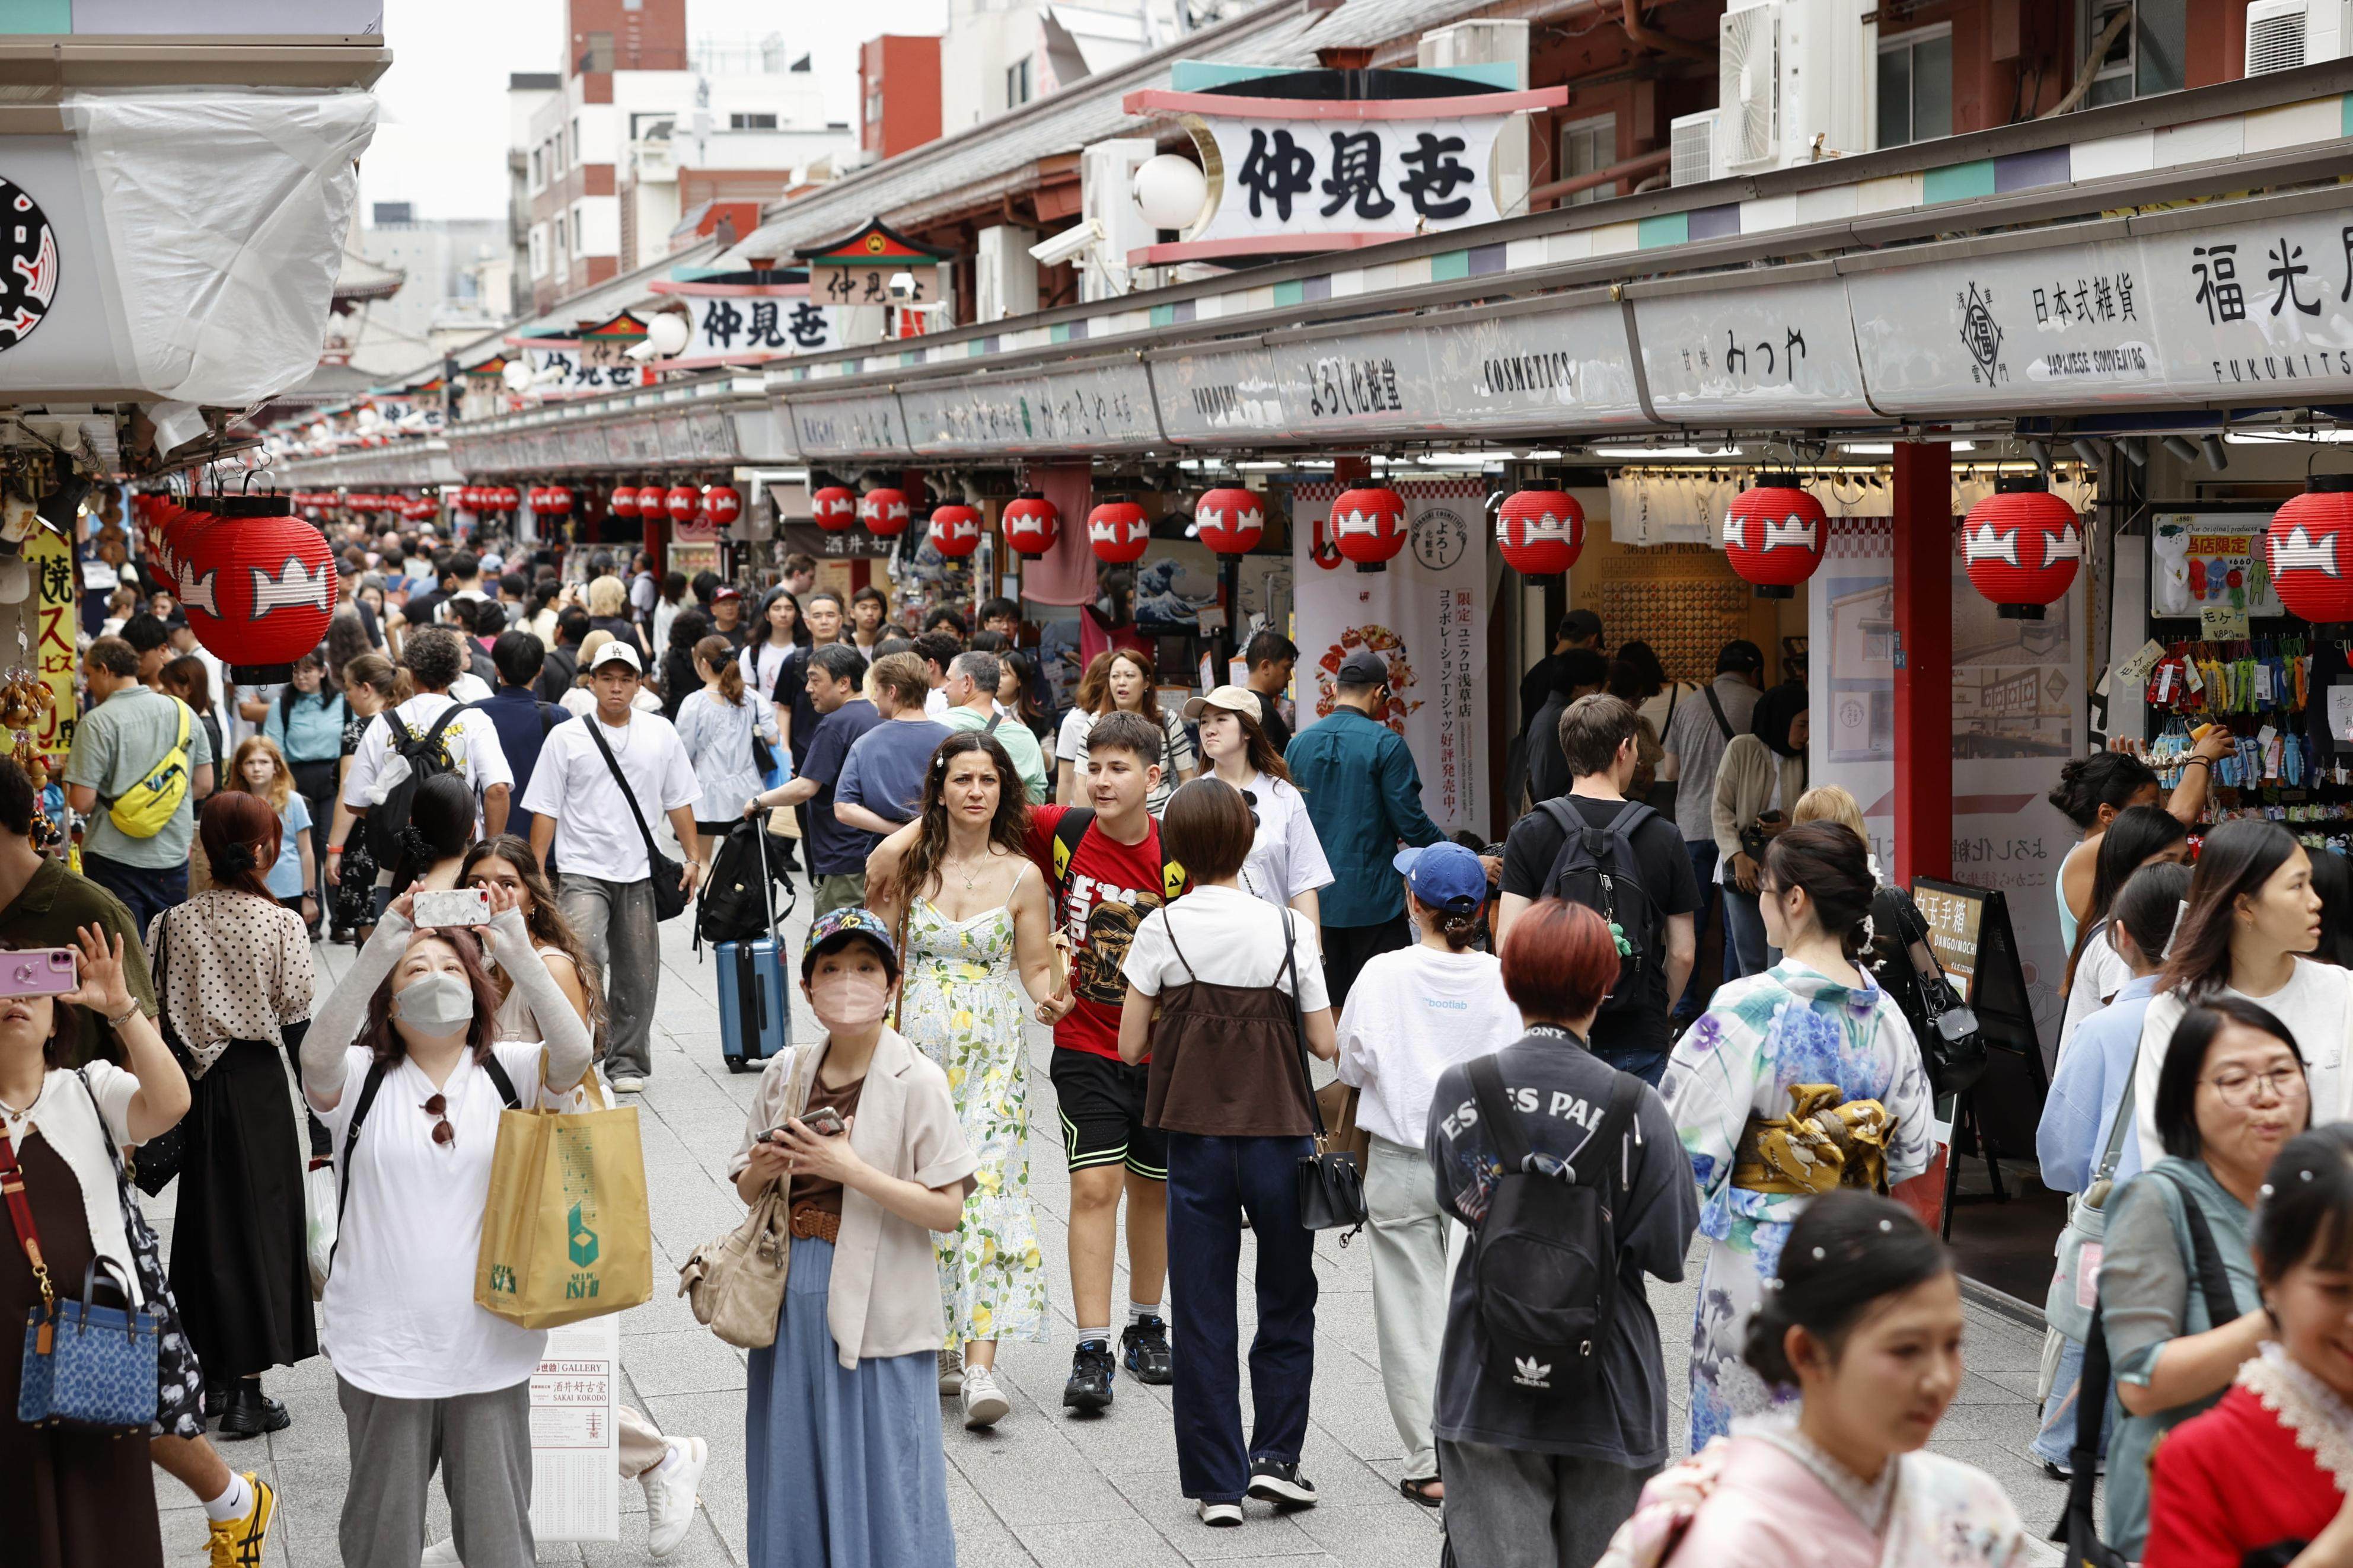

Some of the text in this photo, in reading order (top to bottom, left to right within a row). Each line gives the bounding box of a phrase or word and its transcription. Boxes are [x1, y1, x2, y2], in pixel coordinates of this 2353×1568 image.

[1238, 127, 1475, 222] 仲見世
[2032, 272, 2138, 325] 日本式雑貨
[703, 301, 828, 349] 仲見世
[1681, 326, 1807, 381] 甘味 みつや
[2047, 346, 2146, 376] JAPANESE SOUVENIRS
[1305, 357, 1403, 417] よろし化粧堂
[1484, 352, 1574, 393] COSMETICS
[1191, 385, 1238, 414] YOROSHI
[1436, 522, 1448, 564] よろし
[2186, 523, 2201, 533] Our
[2202, 525, 2230, 534] original
[2188, 536, 2247, 554] 当店限定
[1650, 544, 1673, 555] LIP
[2204, 611, 2245, 624] モケケ
[1457, 592, 1472, 718] 限定 ユニクロ浅草店
[1915, 892, 1966, 934] 白玉手箱
[1934, 934, 1978, 956] DANGO/MOCHI
[553, 1381, 606, 1393] 酒井好古堂
[1512, 1375, 1551, 1388] adidas
